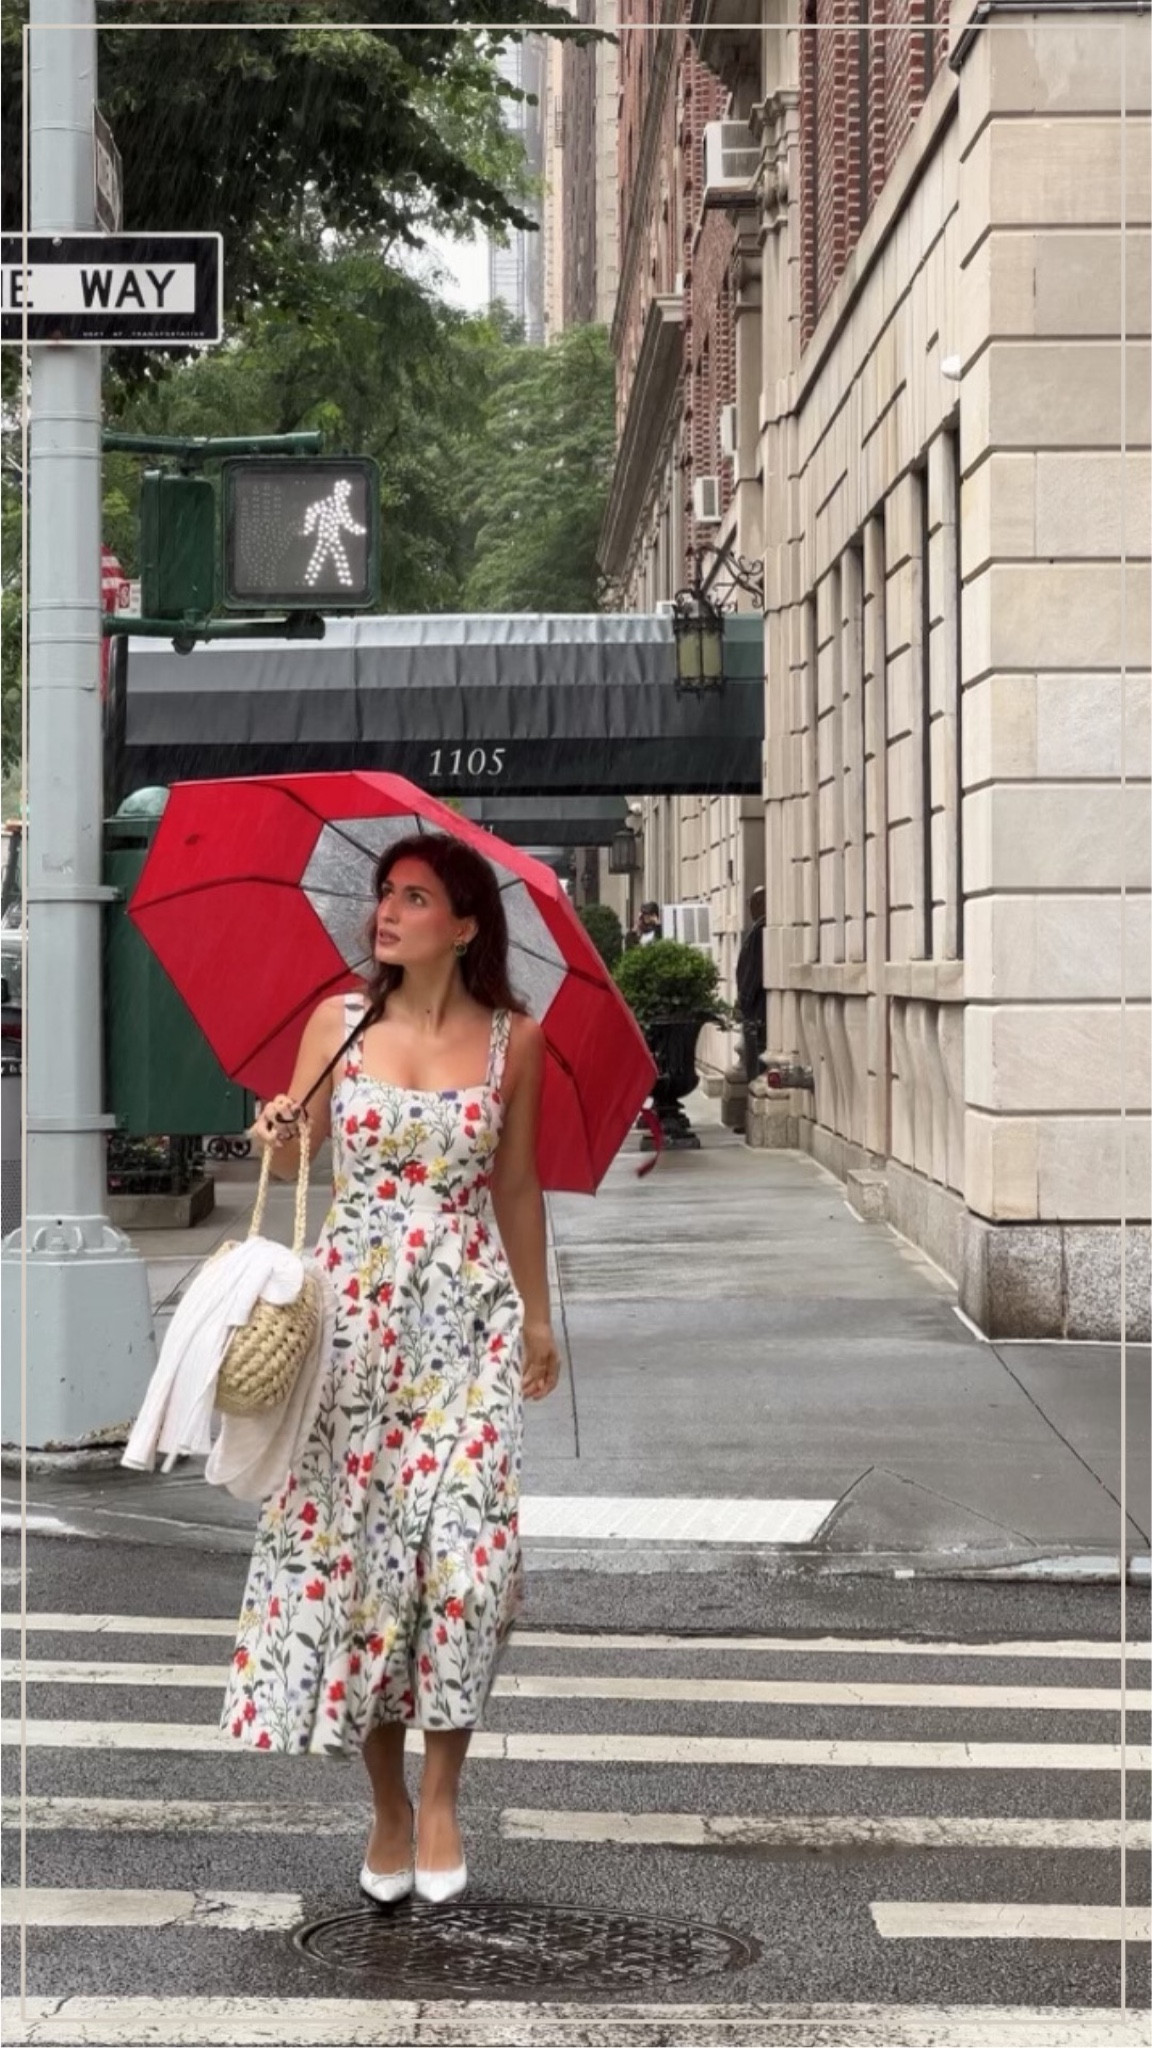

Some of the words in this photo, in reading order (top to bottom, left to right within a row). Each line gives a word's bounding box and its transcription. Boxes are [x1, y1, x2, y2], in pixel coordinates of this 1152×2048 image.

[1, 269, 33, 308] E
[81, 269, 176, 308] WAY
[429, 748, 506, 776] 1105
